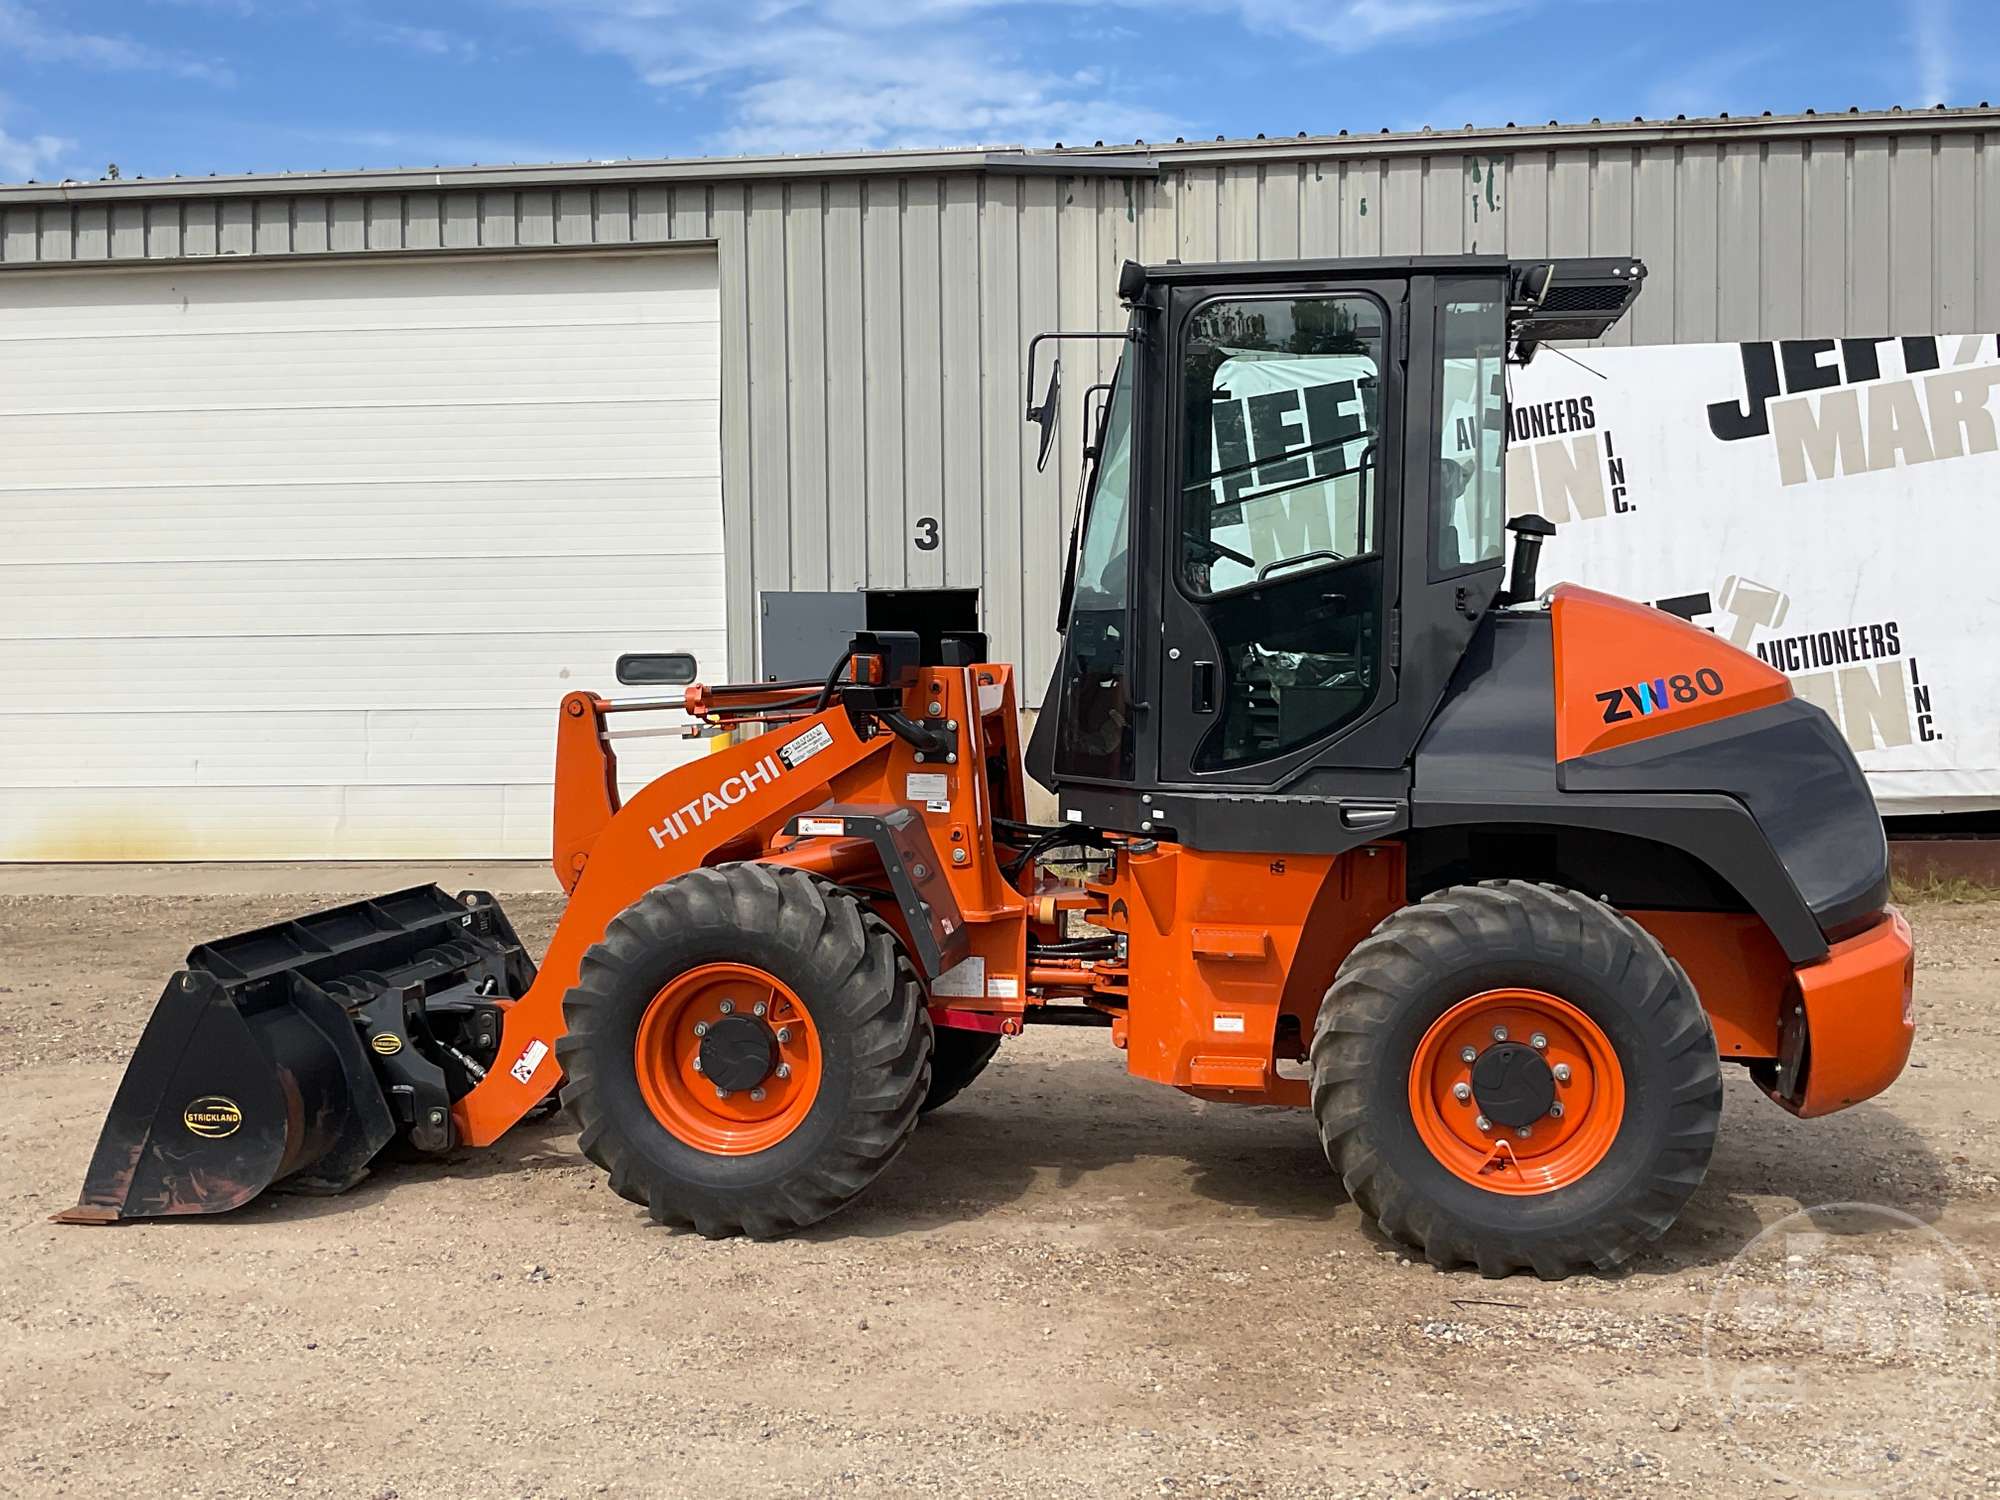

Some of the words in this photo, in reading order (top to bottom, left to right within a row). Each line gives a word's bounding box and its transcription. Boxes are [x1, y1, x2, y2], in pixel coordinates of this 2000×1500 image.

[914, 517, 940, 551] 3
[1595, 667, 1724, 724] ZW80
[648, 755, 781, 850] HITACHI
[187, 1113, 239, 1123] STRICKLAND
